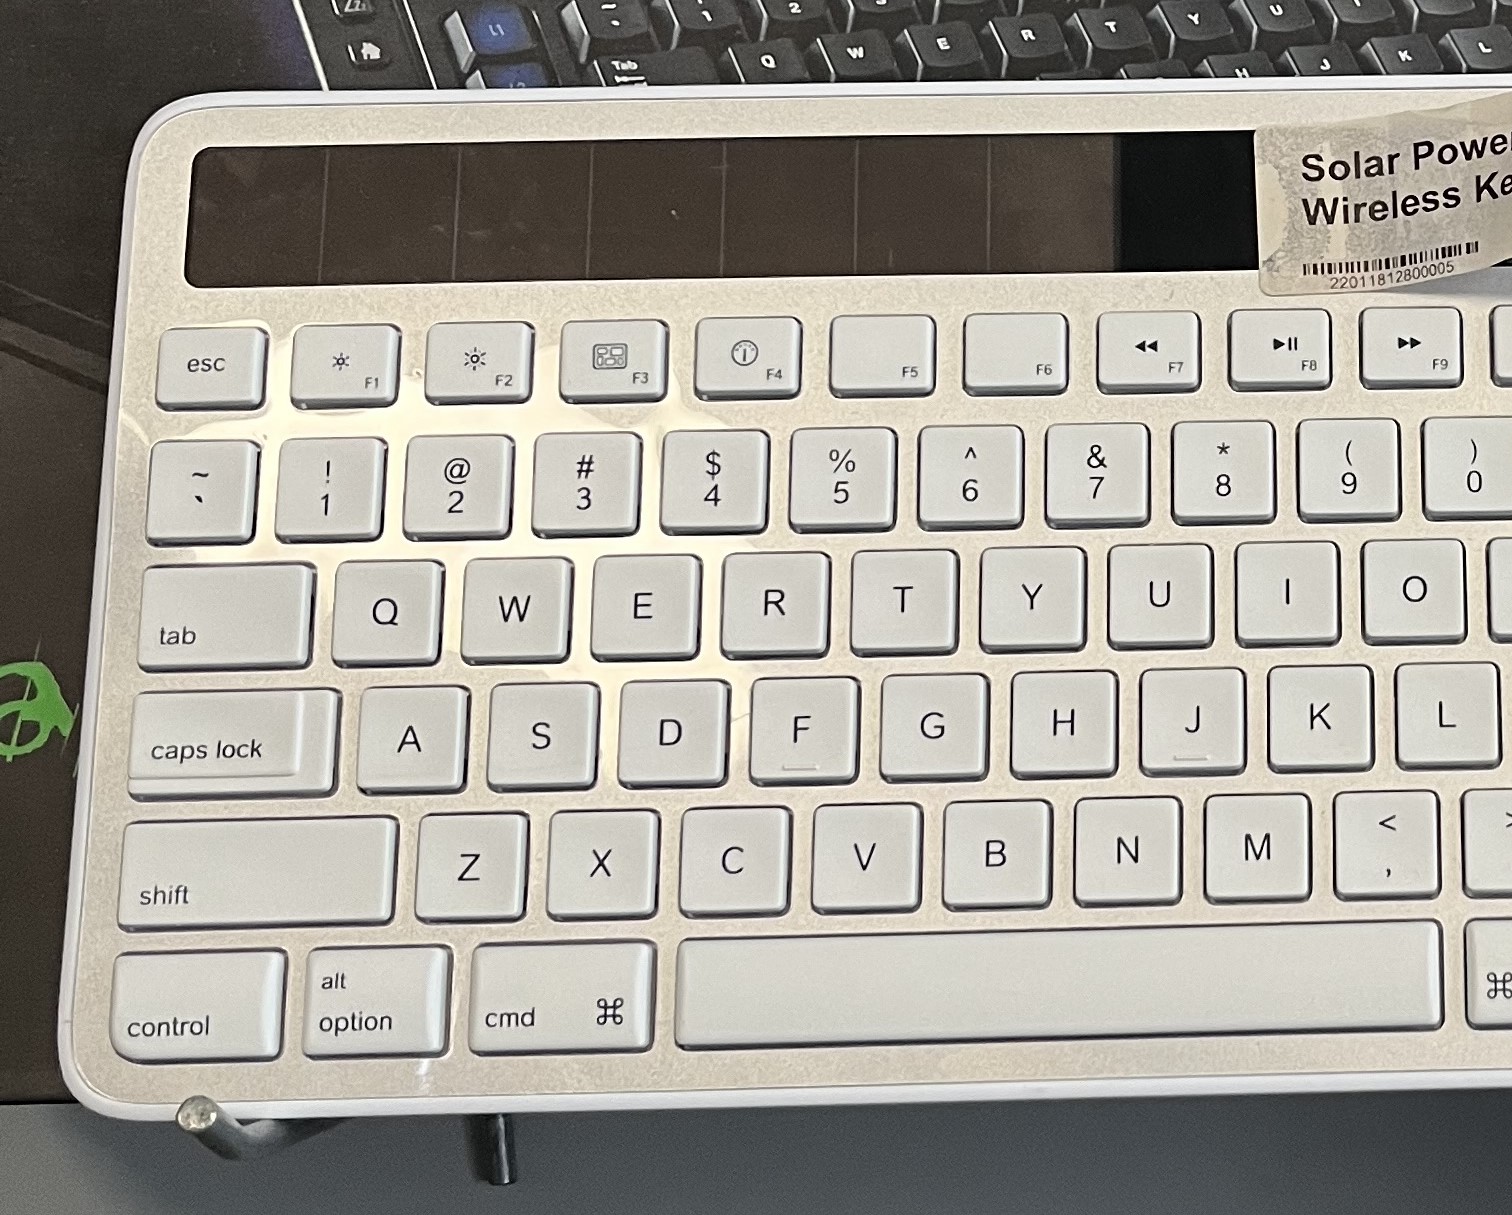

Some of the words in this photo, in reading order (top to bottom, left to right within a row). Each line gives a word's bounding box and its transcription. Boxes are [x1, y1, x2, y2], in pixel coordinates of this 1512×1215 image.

[1188, 13, 1200, 25] Y
[1269, 4, 1284, 16] U
[1021, 29, 1036, 42] R
[1105, 21, 1117, 33] T
[846, 46, 865, 59] W
[937, 38, 951, 51] E
[1398, 50, 1413, 62] K
[1478, 42, 1492, 54] L
[760, 54, 777, 69] Q
[1320, 59, 1332, 71] J
[1301, 149, 1400, 182] Solar
[1301, 186, 1461, 227] Wireless
[1329, 260, 1455, 290] 22011812800005
[187, 357, 226, 373] esc
[766, 367, 783, 381] F4
[902, 366, 919, 378] F5
[1036, 363, 1053, 376] F6
[1168, 361, 1184, 374] F7
[1301, 359, 1318, 372] F8
[1432, 358, 1449, 371] F9
[364, 376, 379, 389] F1
[495, 374, 513, 387] F2
[632, 371, 649, 385] F3
[705, 449, 722, 481] $
[828, 448, 856, 474] %
[964, 446, 977, 460] ^
[1086, 444, 1108, 469] &
[443, 457, 471, 485] @
[576, 454, 595, 480] #
[833, 480, 850, 505] 5
[962, 478, 979, 503] 6
[1089, 476, 1105, 500] 7
[1215, 473, 1232, 497] 8
[1341, 471, 1358, 495] 9
[1466, 470, 1483, 493] 0
[319, 493, 330, 517] 1
[447, 490, 464, 514] 2
[576, 486, 592, 511] 3
[703, 483, 722, 507] 4
[892, 585, 914, 614] T
[1021, 583, 1043, 611] Y
[1149, 580, 1171, 608] U
[1402, 575, 1428, 603] O
[372, 597, 399, 626] Q
[498, 594, 531, 623] W
[633, 592, 653, 620] E
[763, 588, 786, 616] R
[160, 625, 197, 646] tab
[920, 711, 945, 740] G
[1052, 708, 1075, 737] H
[1184, 705, 1201, 734] J
[1309, 702, 1332, 731] K
[1438, 700, 1457, 728] L
[396, 725, 422, 754] A
[532, 721, 551, 750] S
[659, 718, 683, 747] D
[792, 715, 812, 744] F
[151, 744, 208, 765] caps
[216, 738, 262, 759] lock
[1378, 814, 1397, 831] <
[853, 842, 877, 872] V
[985, 839, 1007, 868] B
[1116, 835, 1139, 865] N
[1244, 832, 1271, 862] M
[457, 853, 481, 882] Z
[589, 848, 612, 878] X
[721, 846, 744, 875] C
[139, 884, 189, 906] shift
[321, 972, 347, 990] alt
[127, 1014, 210, 1038] control
[318, 1010, 393, 1038] option
[485, 1006, 536, 1028] cmd
